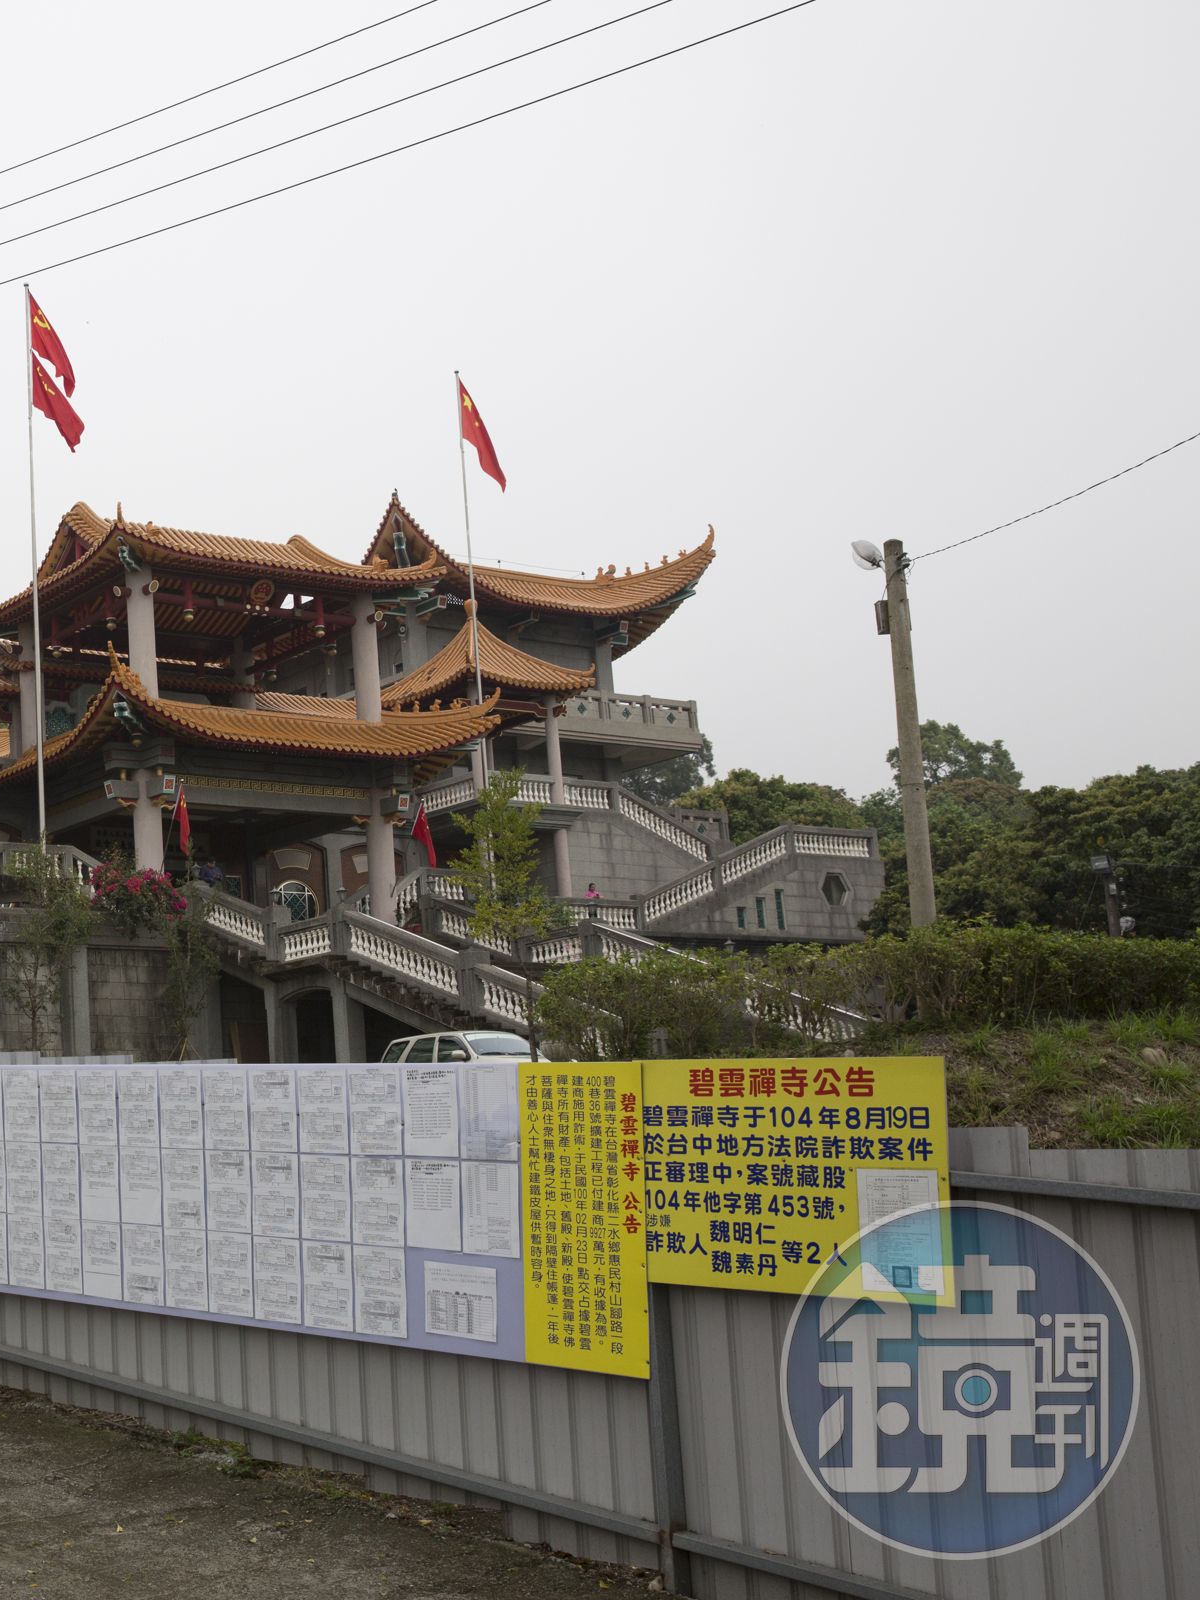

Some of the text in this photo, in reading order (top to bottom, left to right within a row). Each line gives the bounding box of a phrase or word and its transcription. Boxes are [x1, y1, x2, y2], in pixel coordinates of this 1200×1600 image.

[689, 1067, 875, 1098] 碧雲禪寺公告
[643, 1105, 930, 1130] 碧雲禪寺于104年8月19日
[644, 1132, 934, 1161] 於台中地方法院詐欺案件
[646, 1231, 708, 1256] 詐欺人
[710, 1221, 776, 1245] 魏明仁
[711, 1250, 778, 1277] 魏素丹
[781, 1240, 848, 1267] 等2人
